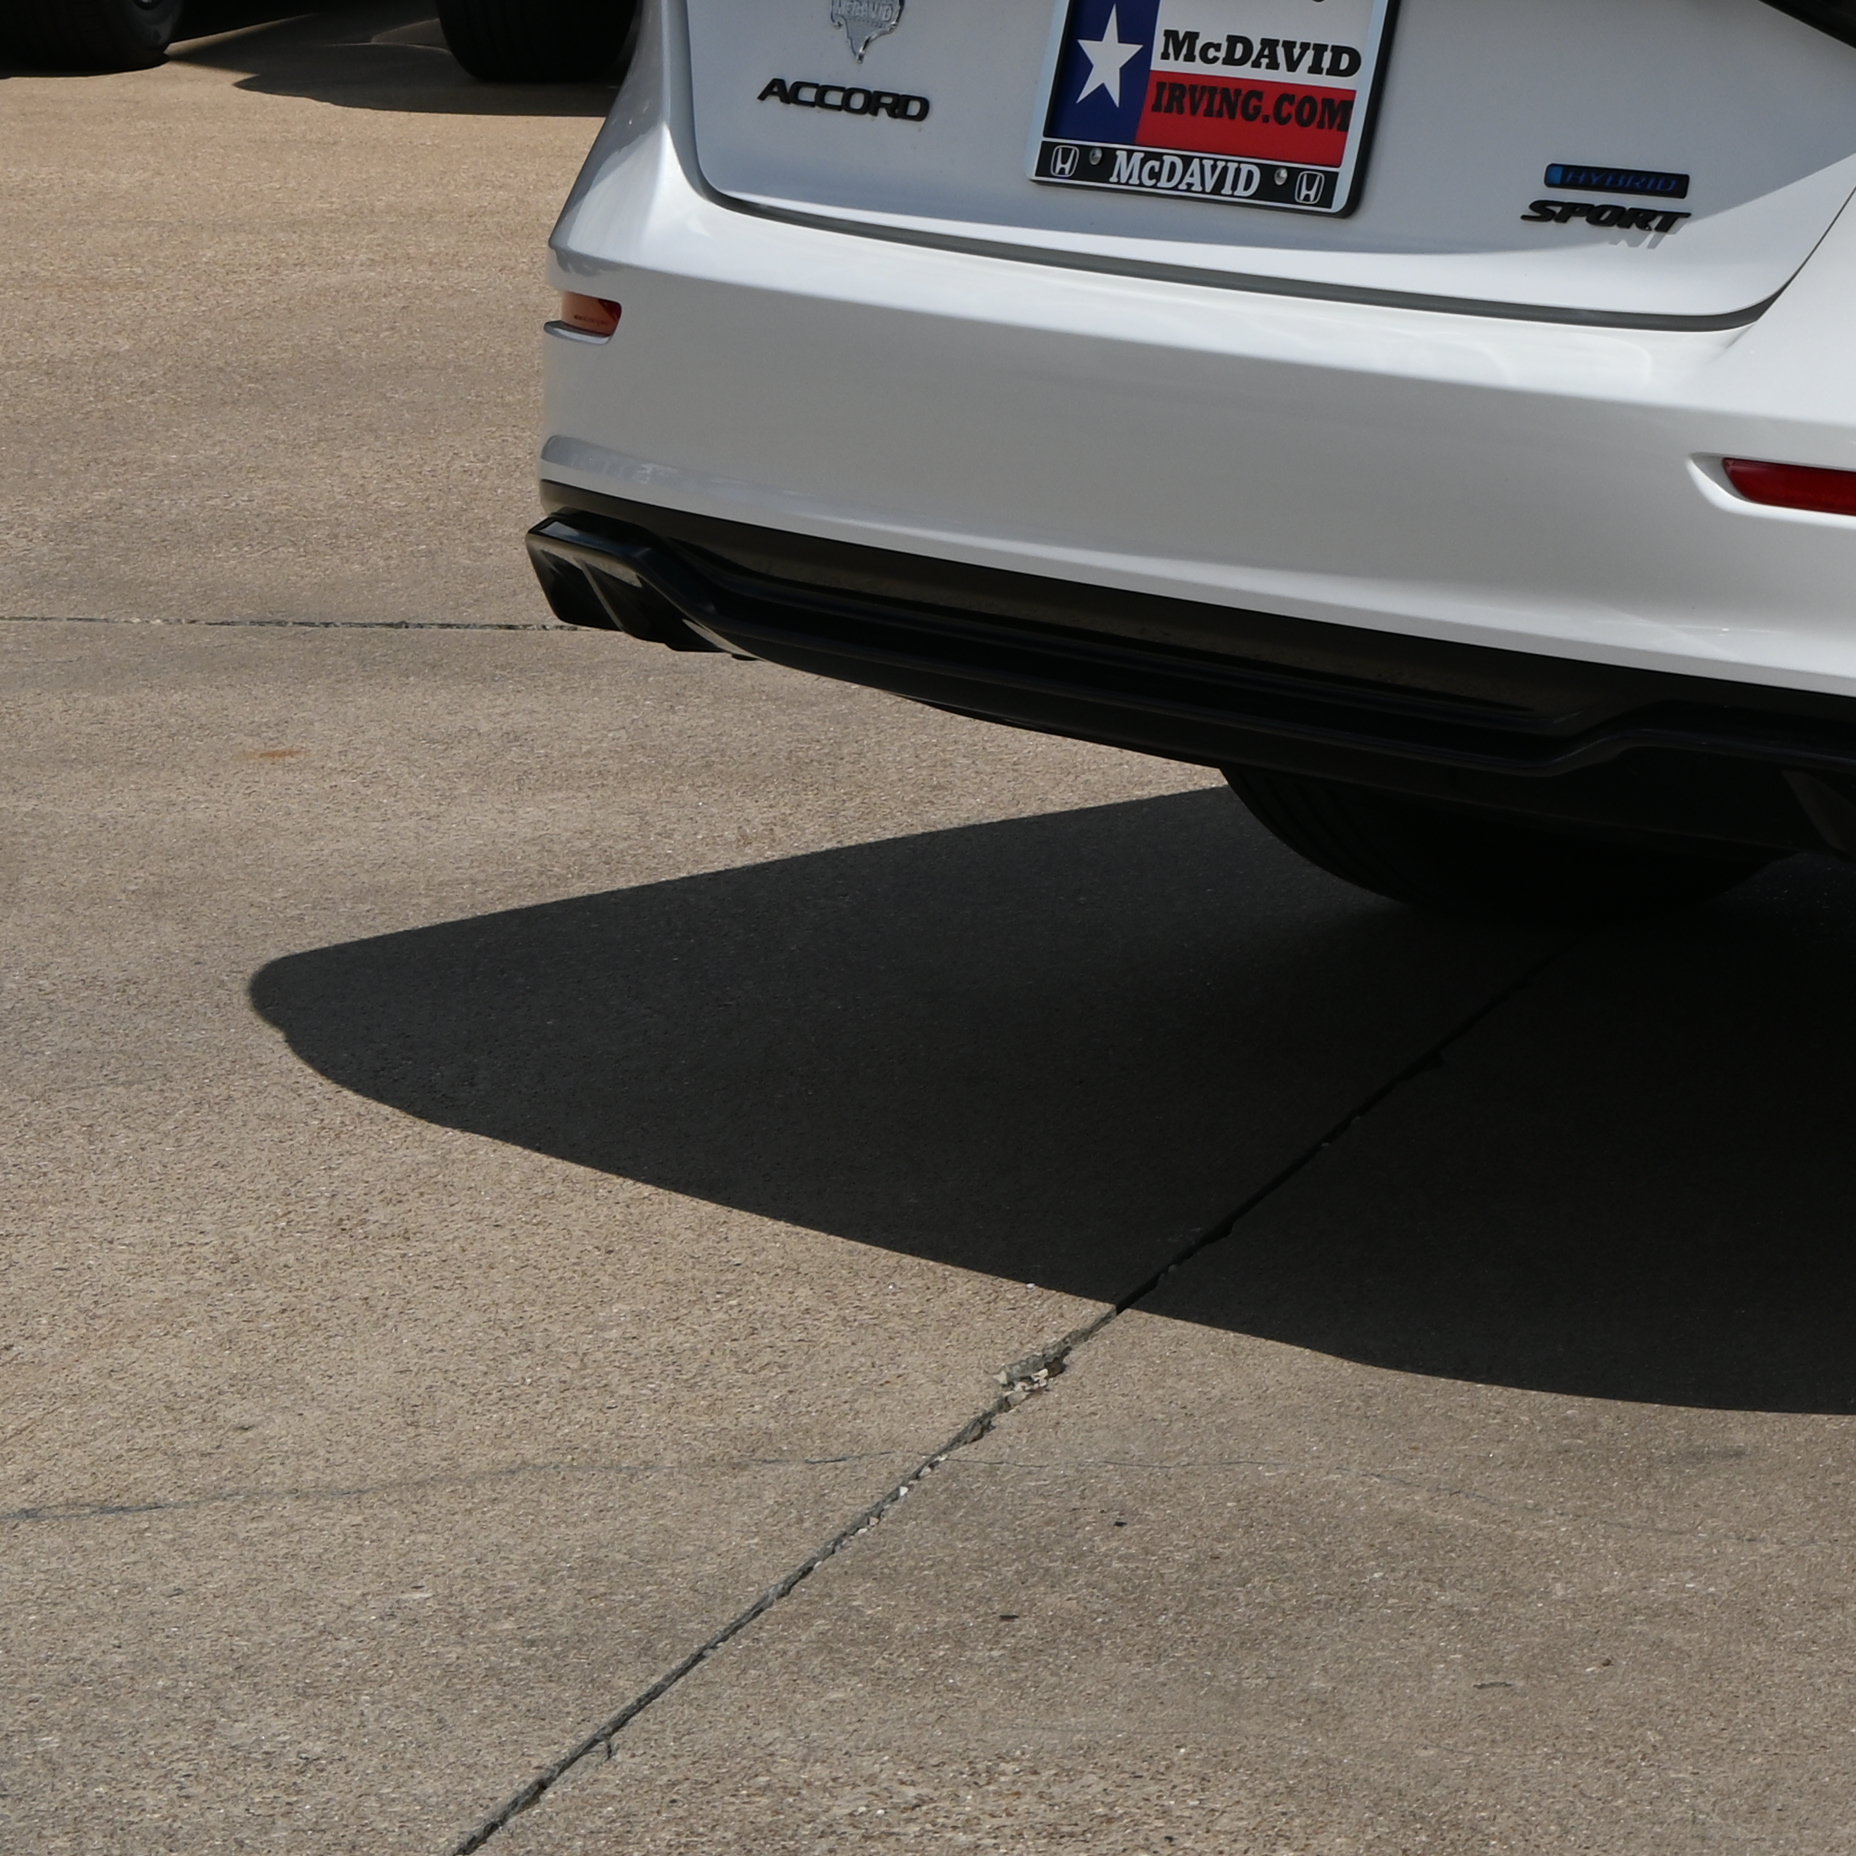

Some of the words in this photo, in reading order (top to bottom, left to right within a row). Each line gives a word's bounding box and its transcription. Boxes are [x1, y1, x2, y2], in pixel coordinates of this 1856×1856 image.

[1160, 29, 1361, 78] McDAVID
[757, 78, 930, 122] ACCORD
[1151, 82, 1354, 133] IRVING.COM
[1109, 150, 1261, 197] McDAVID
[1566, 170, 1679, 192] HYBRID
[1520, 200, 1692, 233] SPORT
